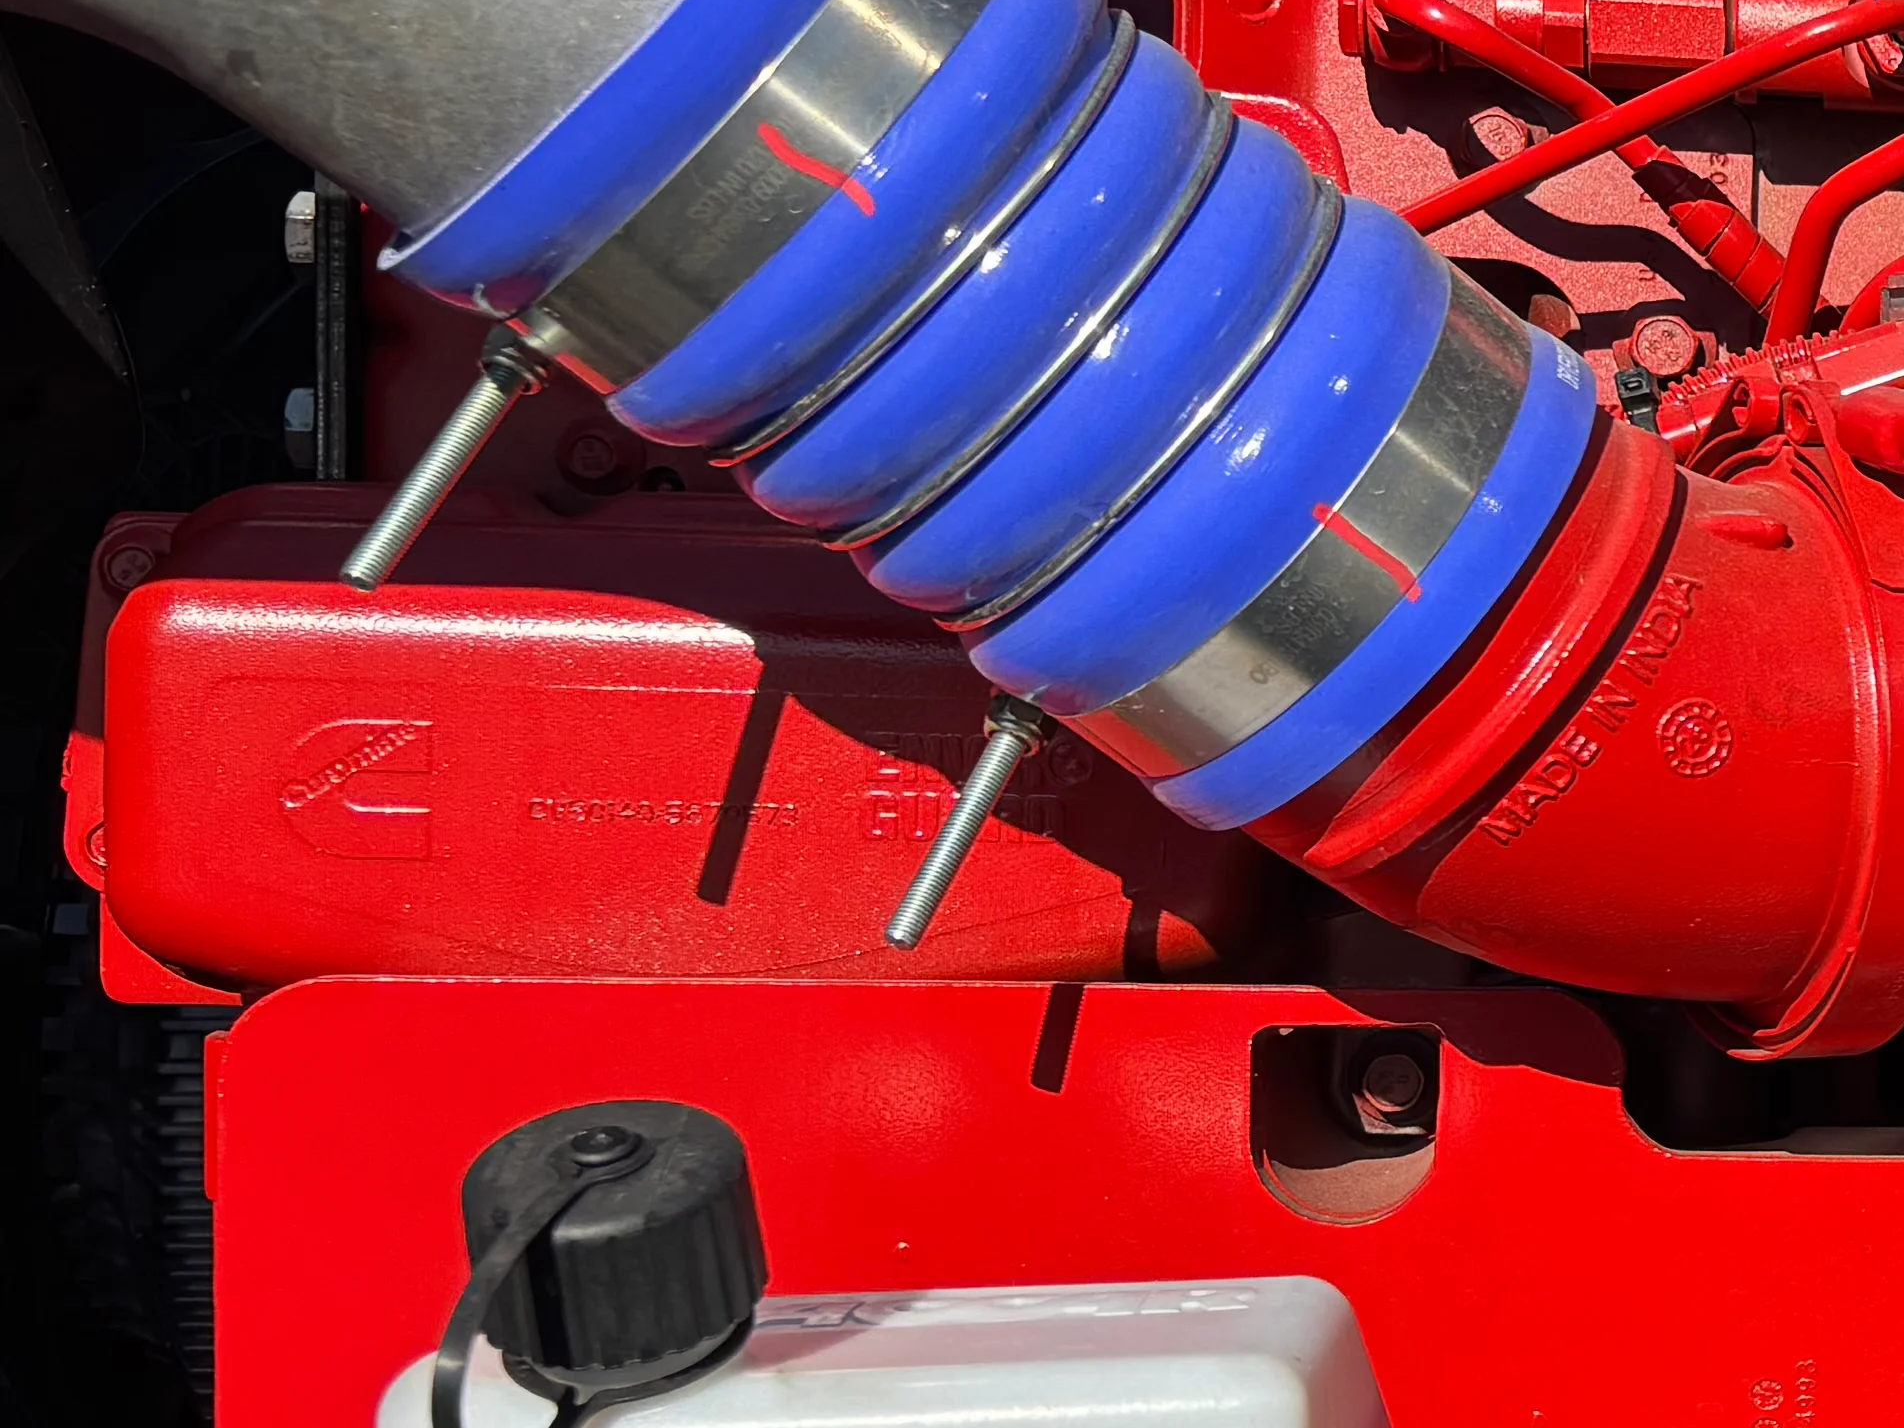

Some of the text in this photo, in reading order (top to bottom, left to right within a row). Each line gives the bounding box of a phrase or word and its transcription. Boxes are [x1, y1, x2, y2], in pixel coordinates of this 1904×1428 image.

[1478, 572, 1704, 848] MADE IN INDIA
